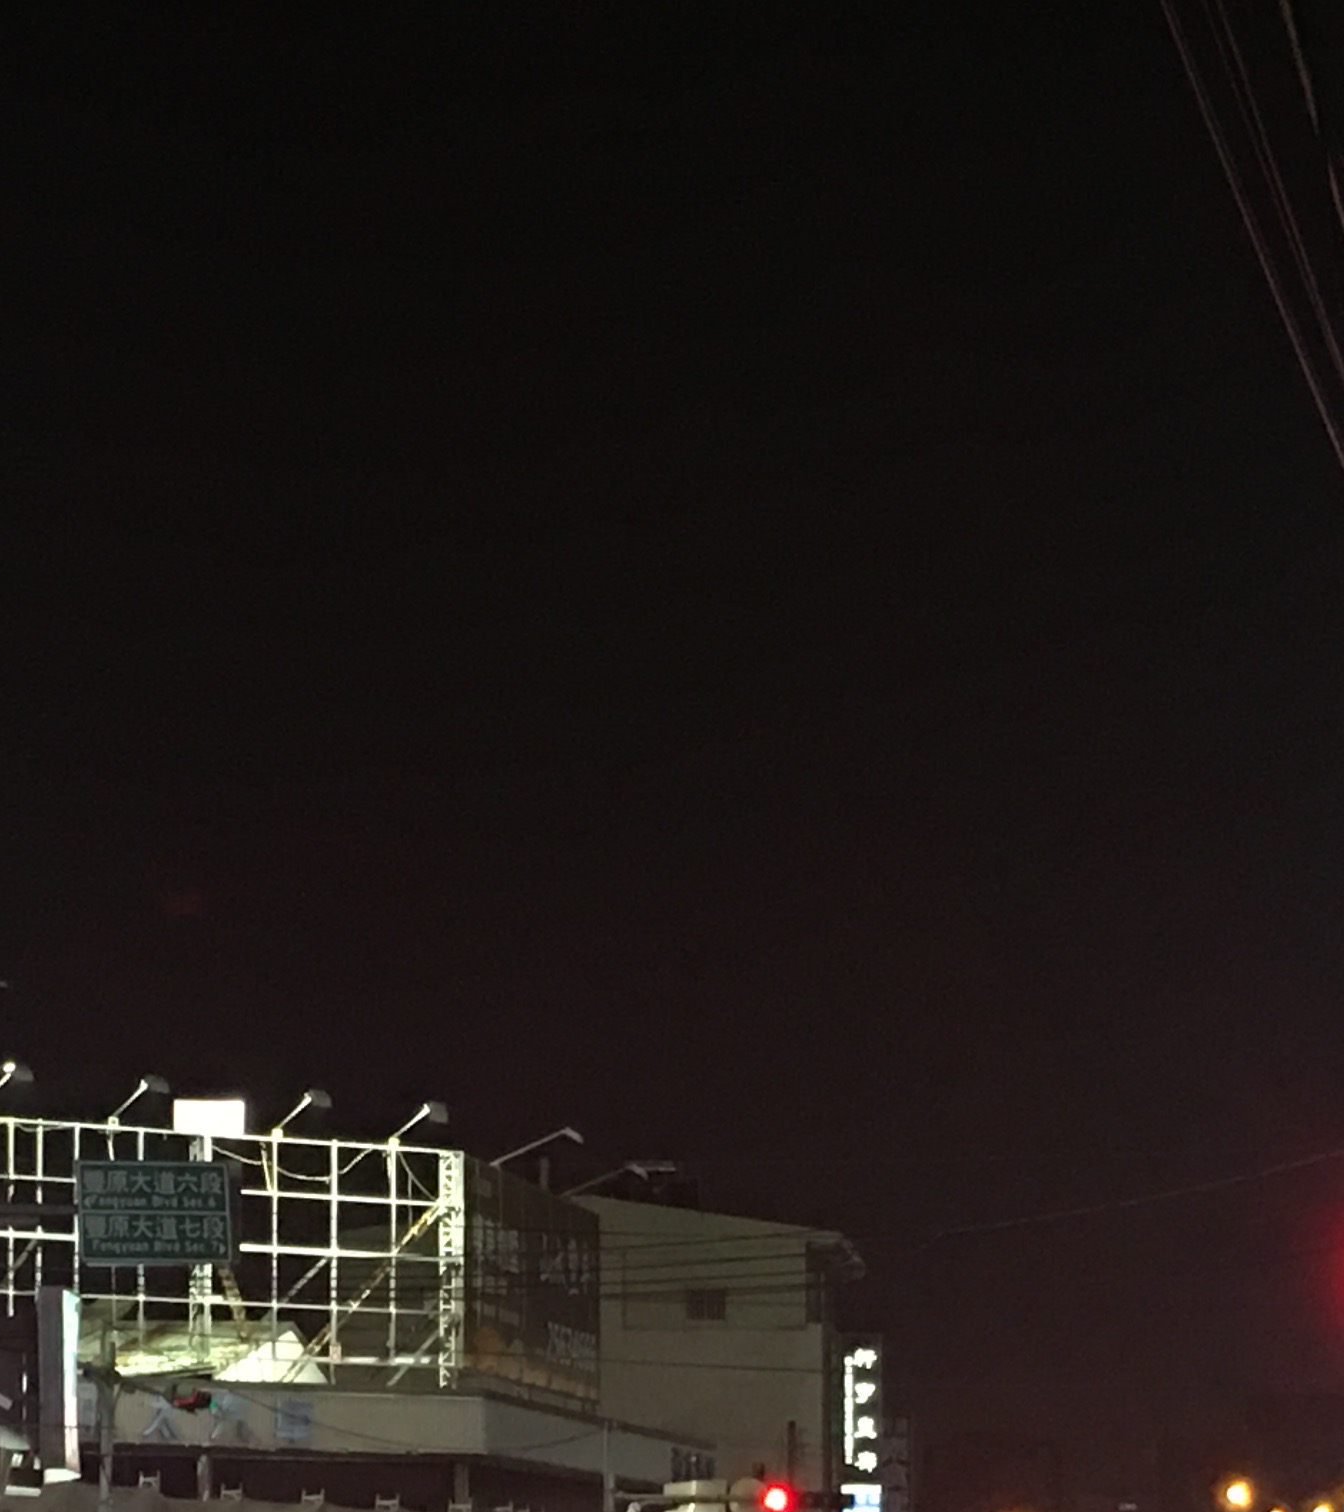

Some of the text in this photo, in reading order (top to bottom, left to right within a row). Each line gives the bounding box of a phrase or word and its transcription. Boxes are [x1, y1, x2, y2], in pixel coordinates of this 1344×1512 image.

[83, 1169, 222, 1194] 豐原大道六段
[85, 1215, 225, 1240] 豐原大道七段
